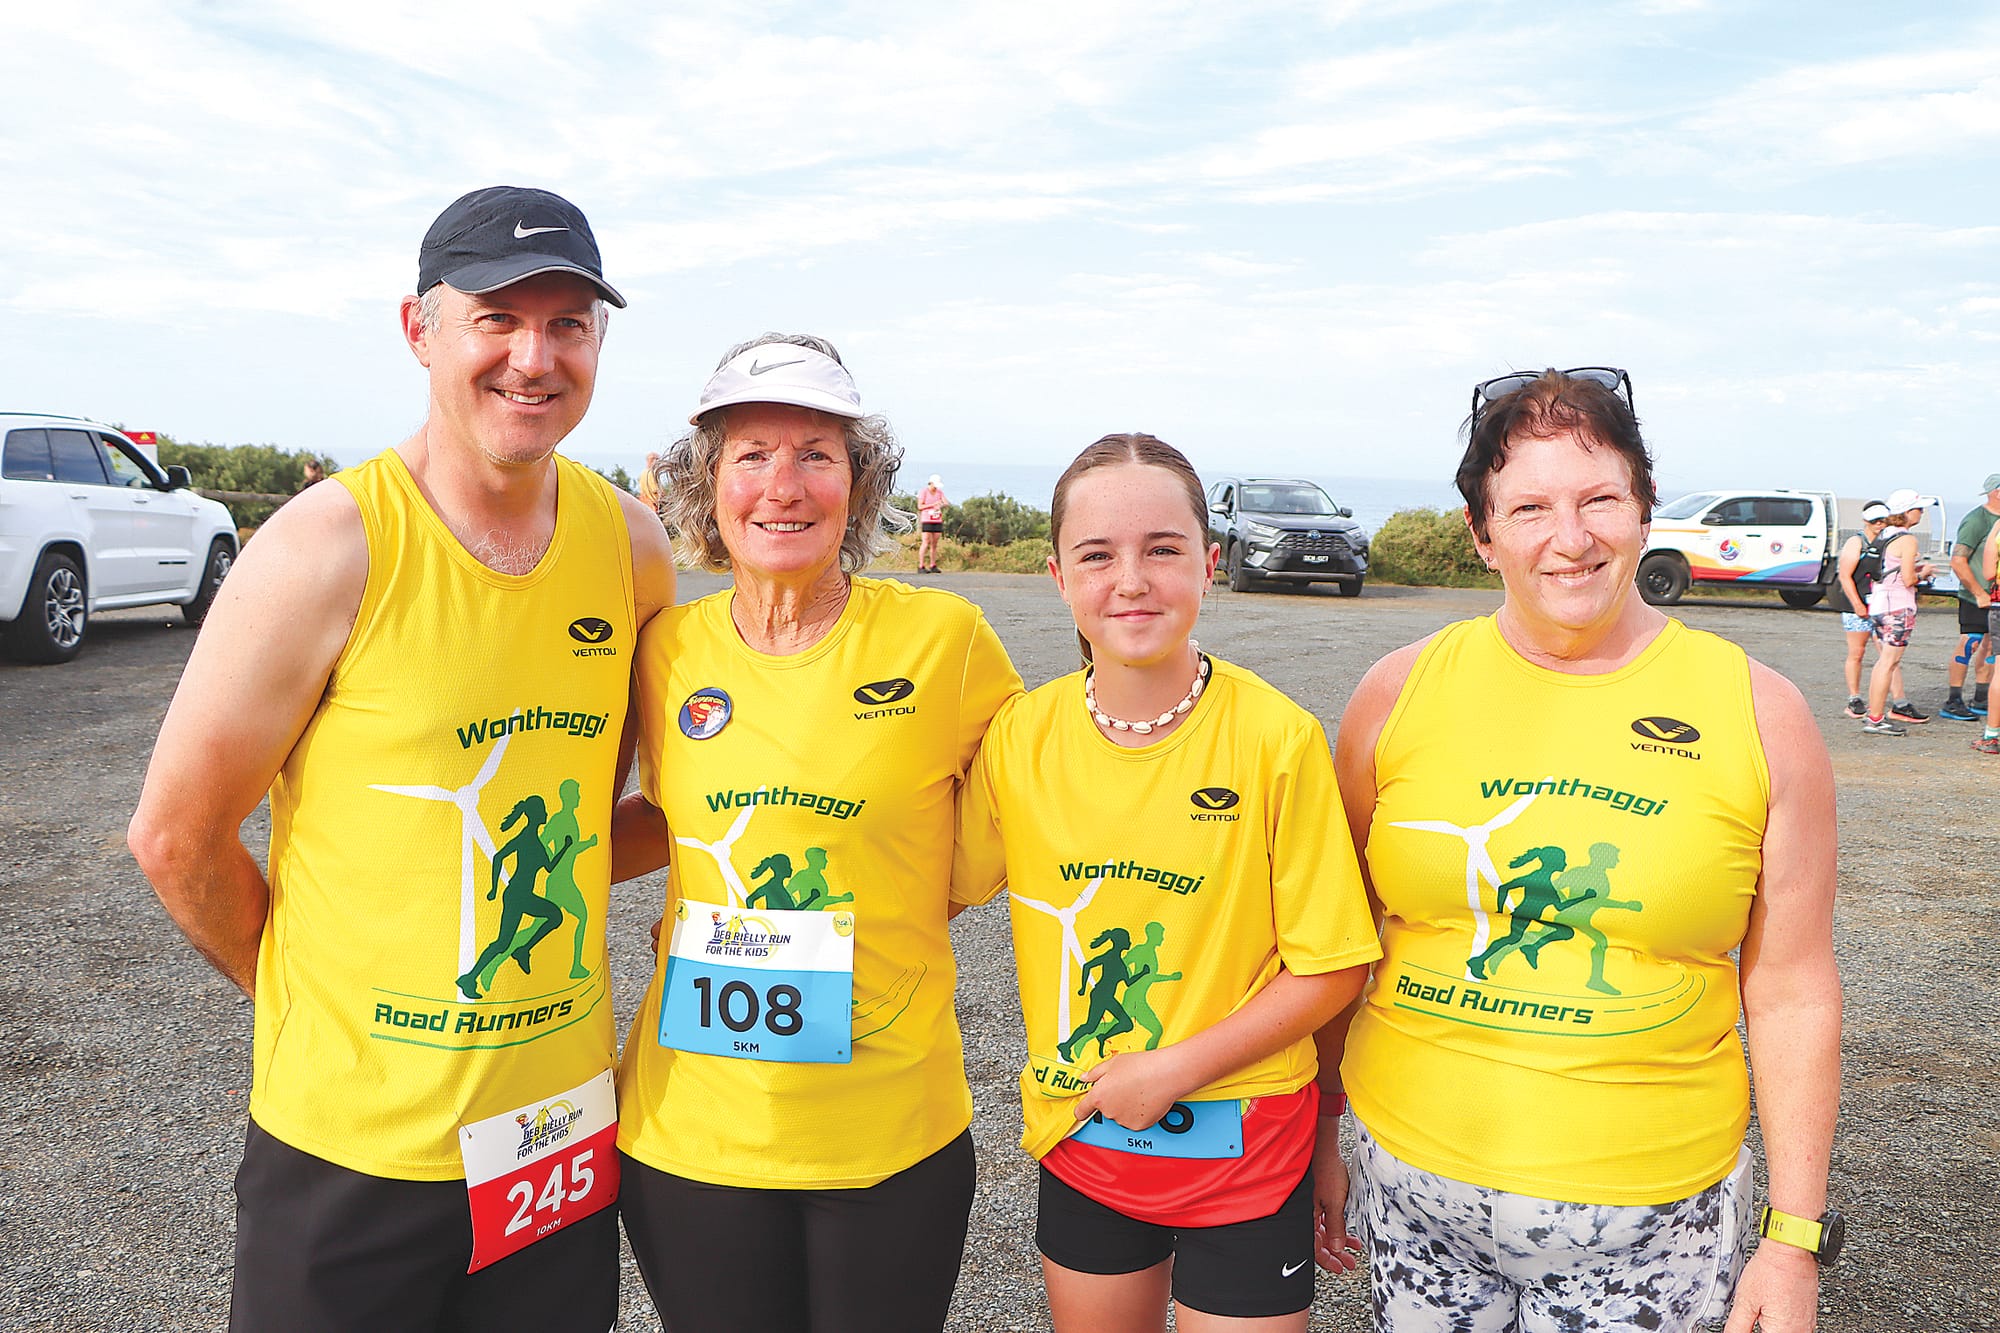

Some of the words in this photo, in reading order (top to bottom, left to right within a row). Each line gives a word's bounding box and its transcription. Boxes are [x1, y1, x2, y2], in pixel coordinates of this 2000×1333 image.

[572, 648, 617, 657] VENTOU
[456, 706, 609, 749] Wonthaggi
[854, 706, 916, 720] VENTOU
[1630, 743, 1701, 760] VENTOU
[705, 786, 866, 820] Wonthaggi
[1481, 778, 1669, 816] Wonthaggi
[1190, 813, 1240, 822] VENTOU
[1059, 861, 1205, 895] Wonthaggi
[706, 945, 722, 955] FOR
[725, 946, 742, 956] THE
[745, 947, 769, 957] KIDS
[713, 929, 732, 940] DEB
[734, 932, 767, 943] RIELLY
[768, 934, 791, 944] RUN
[375, 1003, 449, 1032] Road
[454, 998, 574, 1033] Runners
[693, 976, 803, 1037] 108
[1396, 975, 1456, 1005] Road
[1460, 989, 1594, 1025] Runners
[733, 1041, 760, 1053] 5KM
[523, 1126, 540, 1140] DEB
[541, 1114, 568, 1132] RIELLY
[568, 1107, 584, 1121] RUN
[517, 1146, 533, 1160] FOR
[534, 1136, 550, 1151] THE
[551, 1126, 569, 1143] KIDS
[1127, 1138, 1153, 1149] 5KM
[504, 1149, 595, 1236] 245
[536, 1217, 562, 1236] 10KM
